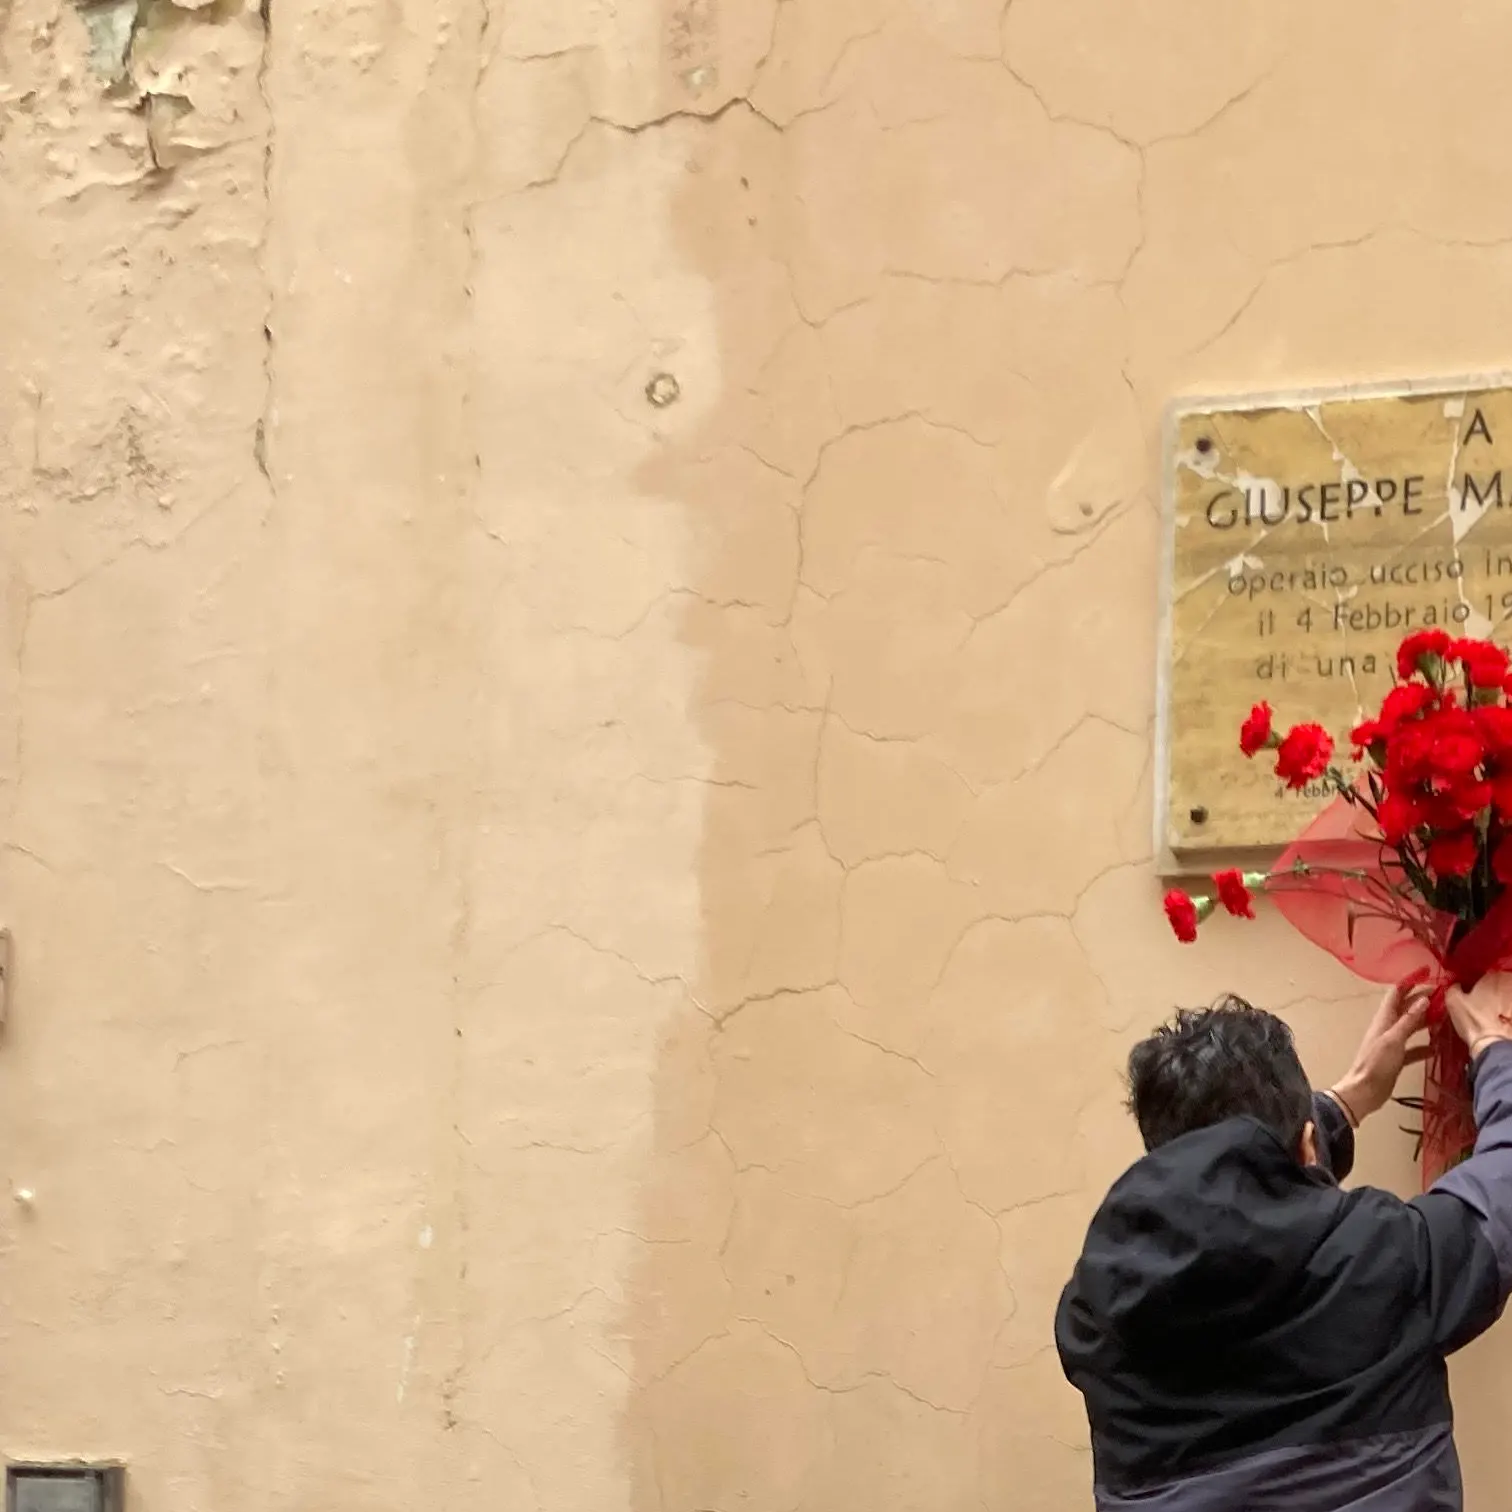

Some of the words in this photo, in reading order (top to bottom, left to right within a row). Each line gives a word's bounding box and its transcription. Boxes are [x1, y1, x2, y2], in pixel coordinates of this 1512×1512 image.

[1463, 408, 1493, 446] A
[1206, 475, 1424, 530] GIUSEPPE
[1227, 562, 1348, 601] operaio
[1369, 557, 1465, 586] ucciso
[1257, 608, 1276, 638] il
[1296, 606, 1313, 634] 4
[1333, 599, 1471, 632] Febbraio
[1256, 654, 1287, 681] di
[1316, 652, 1377, 679] una
